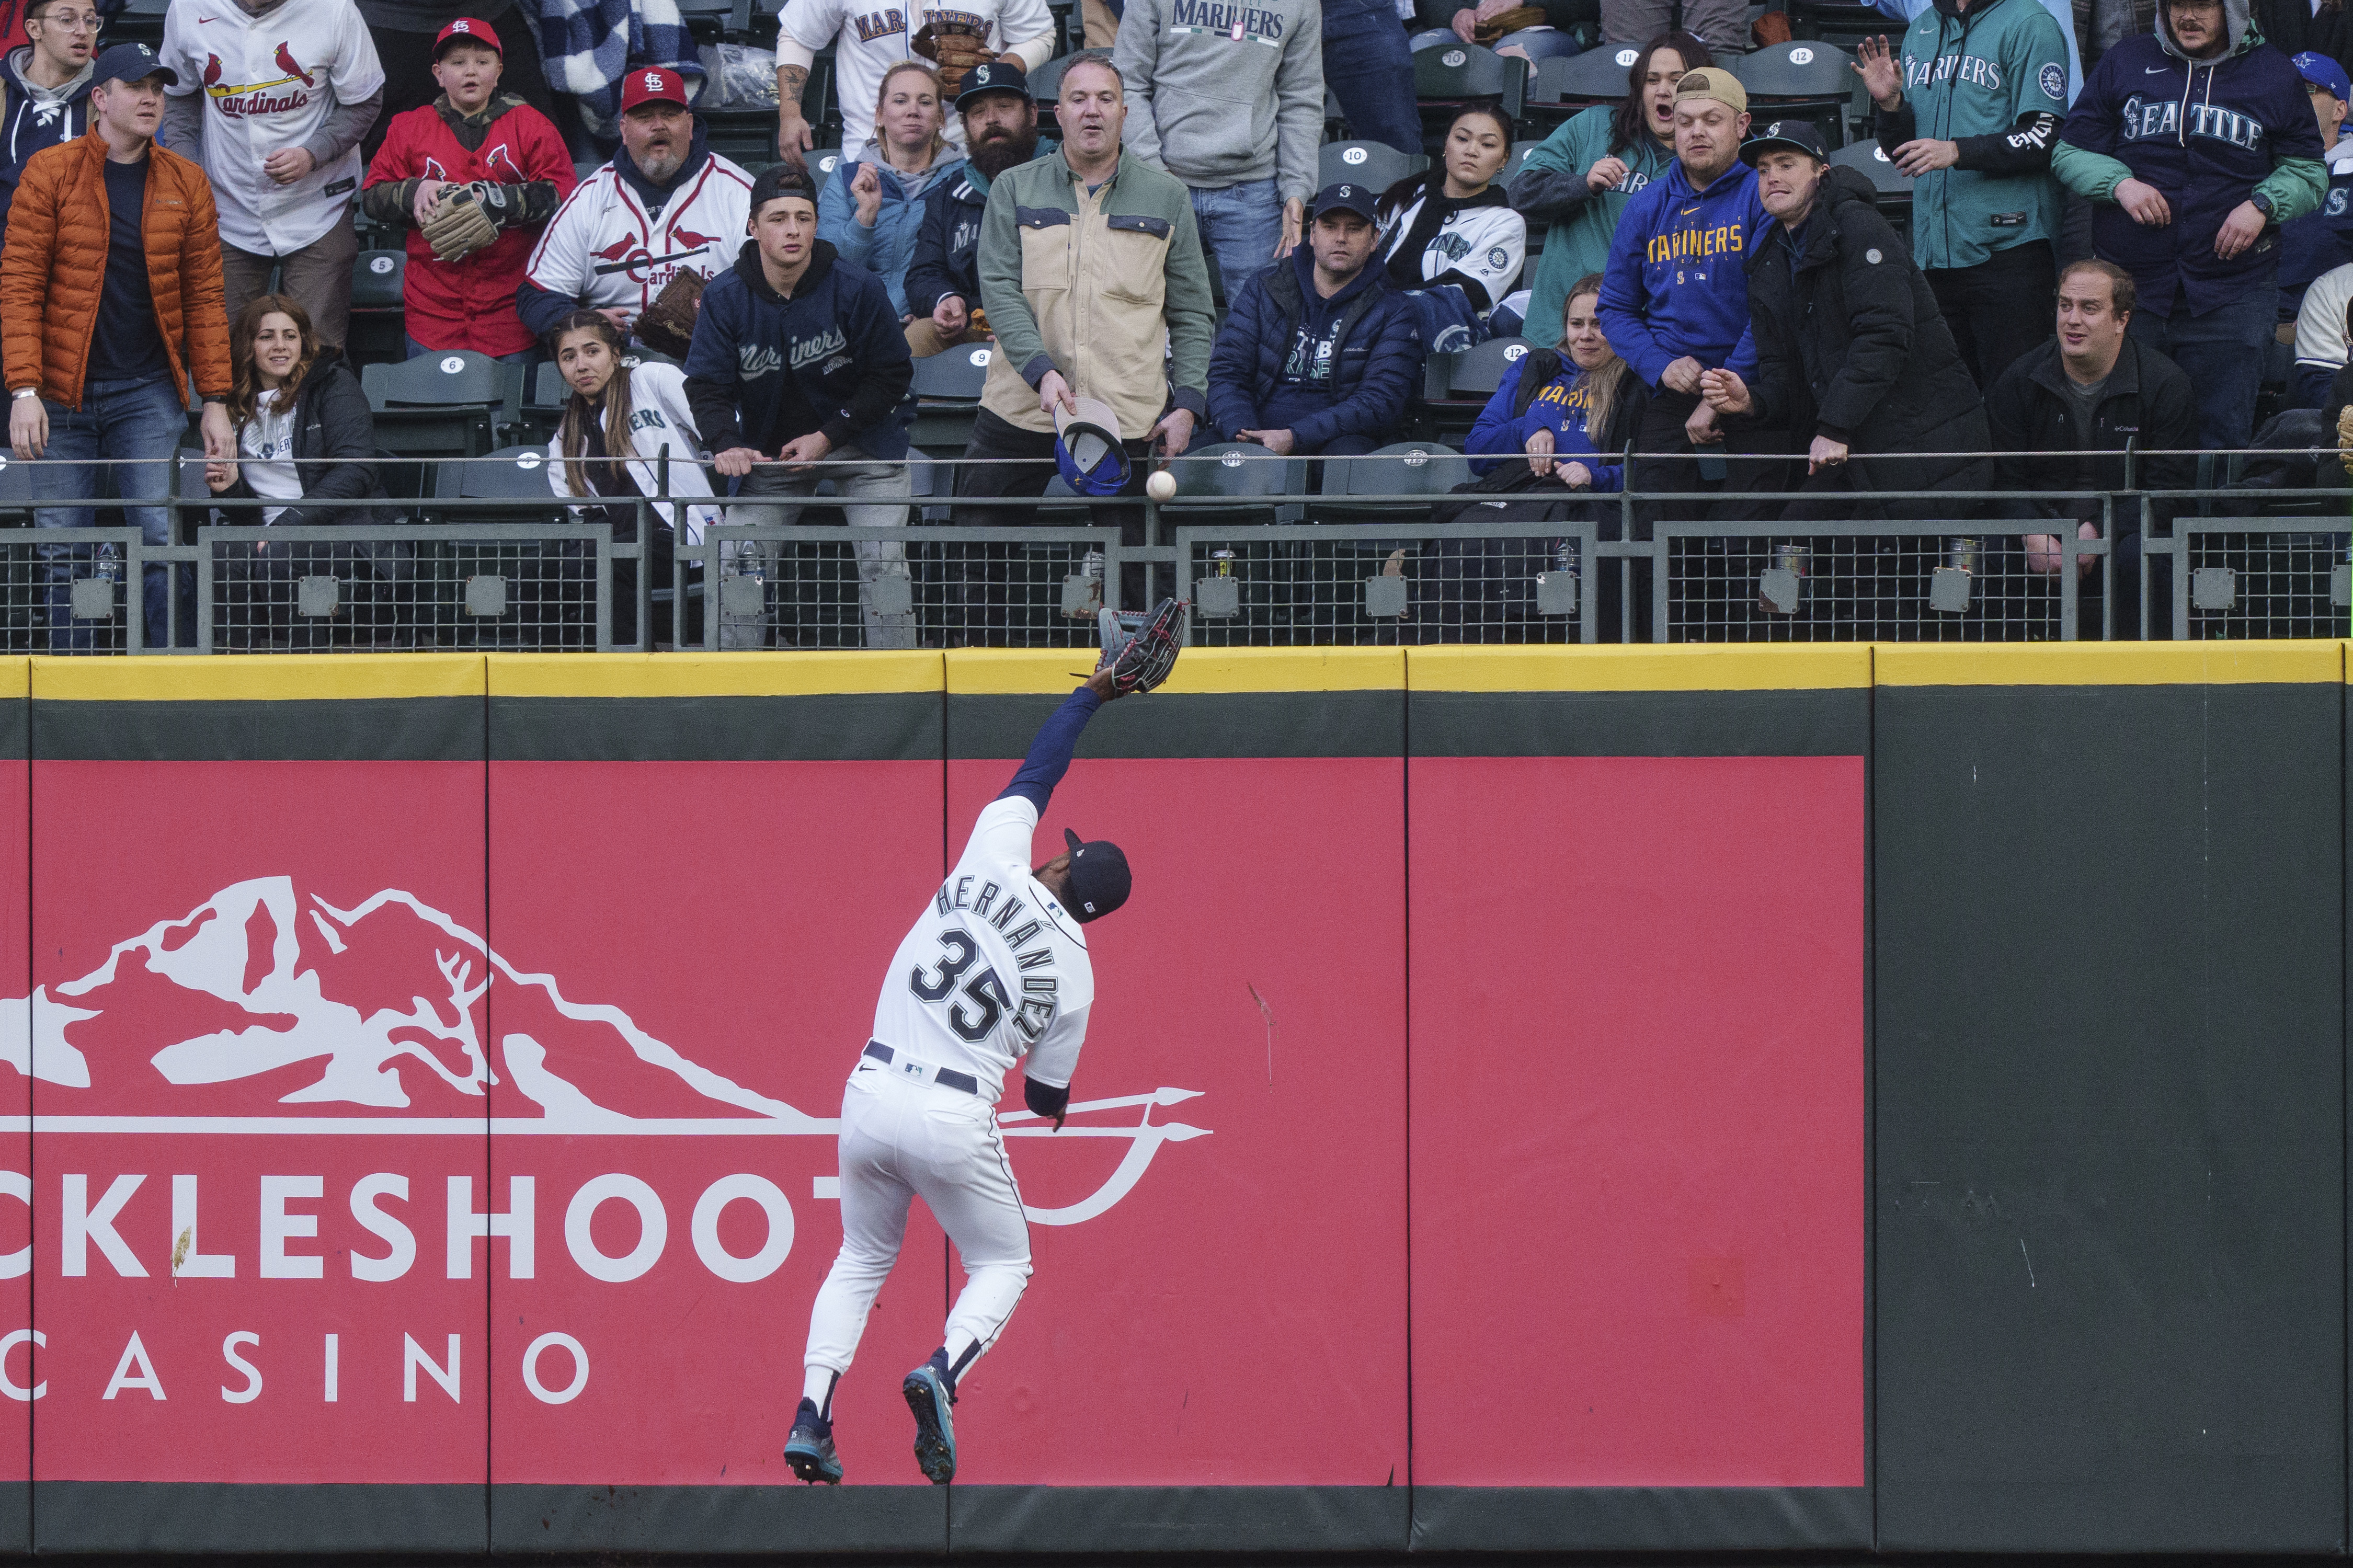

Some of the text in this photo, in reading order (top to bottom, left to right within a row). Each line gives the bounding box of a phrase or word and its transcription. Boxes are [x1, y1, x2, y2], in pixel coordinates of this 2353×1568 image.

[1448, 54, 1460, 63] 10
[1623, 54, 1632, 62] 11
[1796, 52, 1807, 61] 12
[976, 64, 990, 85] S
[214, 89, 310, 119] Cardinals
[2123, 95, 2263, 153] SEATTLE
[1348, 152, 1361, 161] 10
[828, 159, 835, 169] 7
[1339, 186, 1351, 198] S
[2324, 187, 2350, 216] S
[379, 260, 386, 270] 5
[978, 353, 986, 362] 9
[1510, 348, 1522, 358] 12
[449, 360, 456, 370] 6
[630, 409, 667, 436] ERS
[936, 875, 1058, 1040] HERNÁNDEZ
[909, 928, 1013, 1043] 35
[0, 1170, 840, 1283] KLESHOO
[0, 1329, 589, 1404] CASINO
